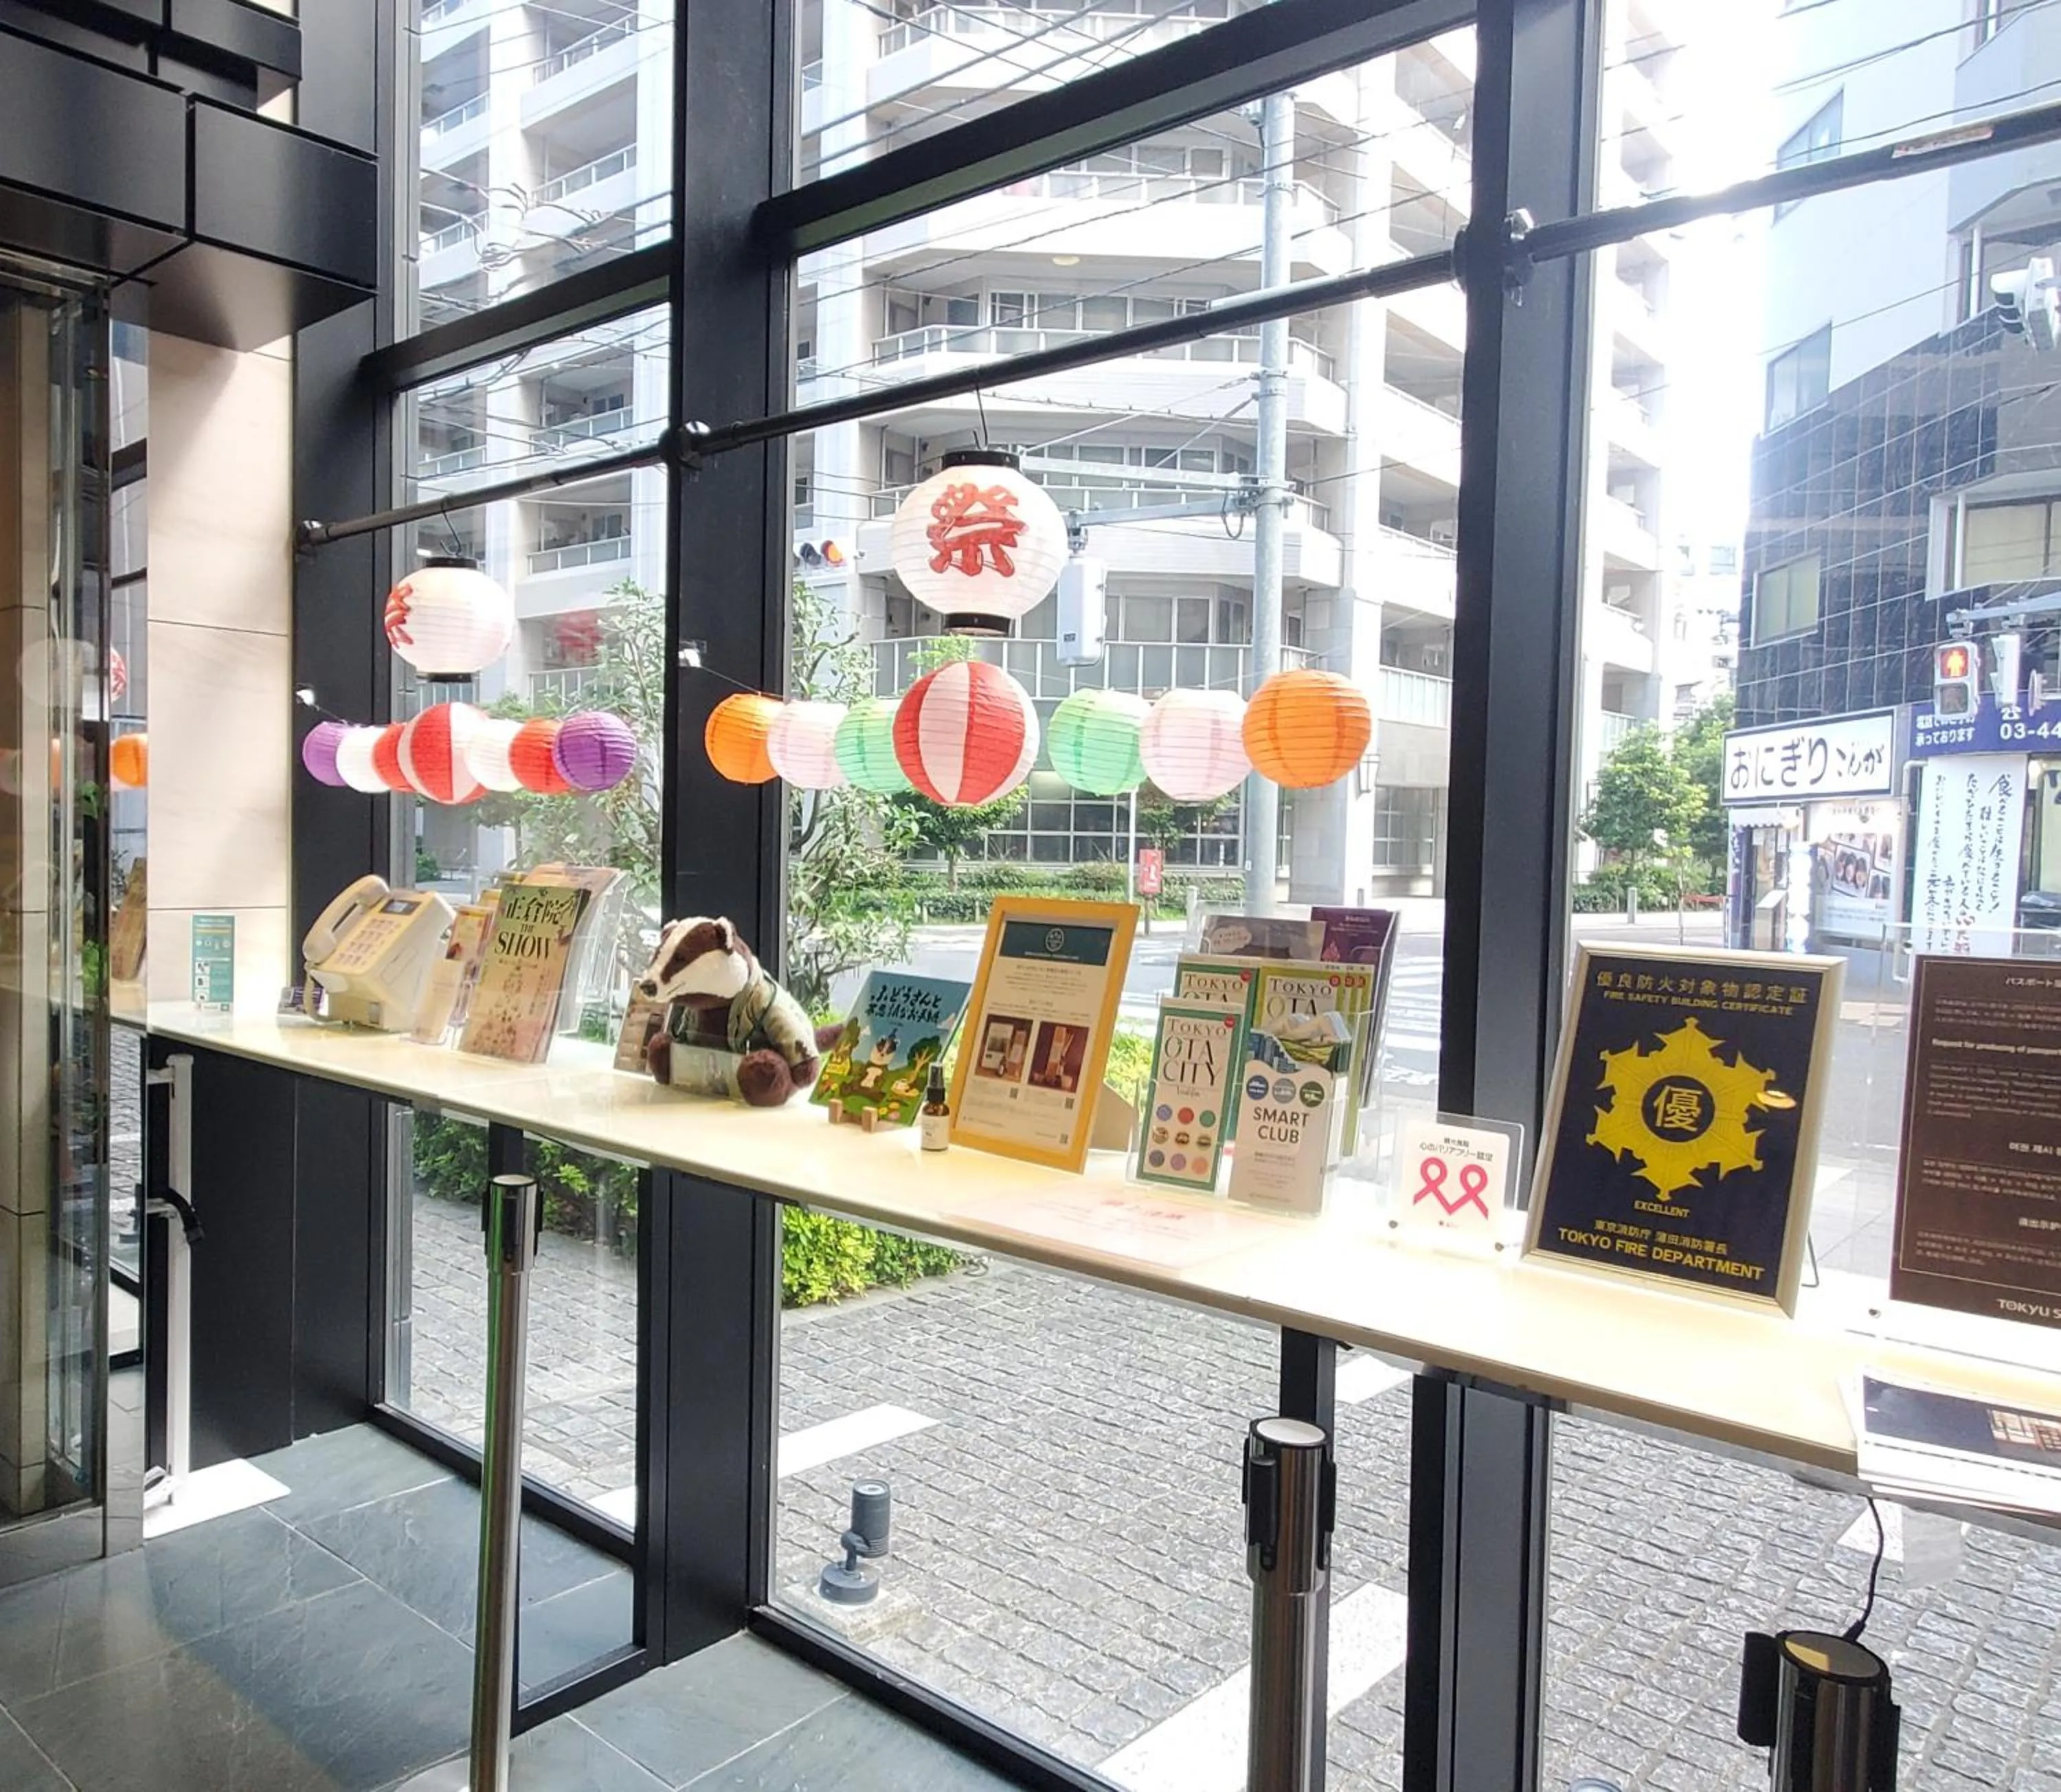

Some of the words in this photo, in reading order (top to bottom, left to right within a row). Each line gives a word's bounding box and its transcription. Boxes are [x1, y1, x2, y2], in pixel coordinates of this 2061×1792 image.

[926, 483, 1029, 577] 祭
[1731, 737, 1827, 789] おにぎり
[494, 930, 550, 960] SHOW
[1184, 974, 1243, 990] TOKYO
[1270, 978, 1332, 995] TOKYO
[1603, 990, 1625, 1000] FIRE
[1628, 992, 1667, 1004] SAFETY
[1671, 997, 1718, 1009] BUILDING
[1722, 1002, 1793, 1016] CERTIFICATE
[1168, 1018, 1226, 1036] TOKYO
[1164, 1035, 1213, 1065] OTA
[1163, 1060, 1222, 1086] CITY
[1253, 1106, 1310, 1128] SMART
[1653, 1085, 1703, 1132] 優
[1258, 1125, 1300, 1144] CLUB
[1634, 1200, 1691, 1218] EXCELLENT
[1558, 1227, 1611, 1249] TOKYO
[1615, 1240, 1647, 1257] FIRE
[1652, 1246, 1766, 1280] DEPARTMENT
[1996, 1298, 2049, 1317] TOKYU
